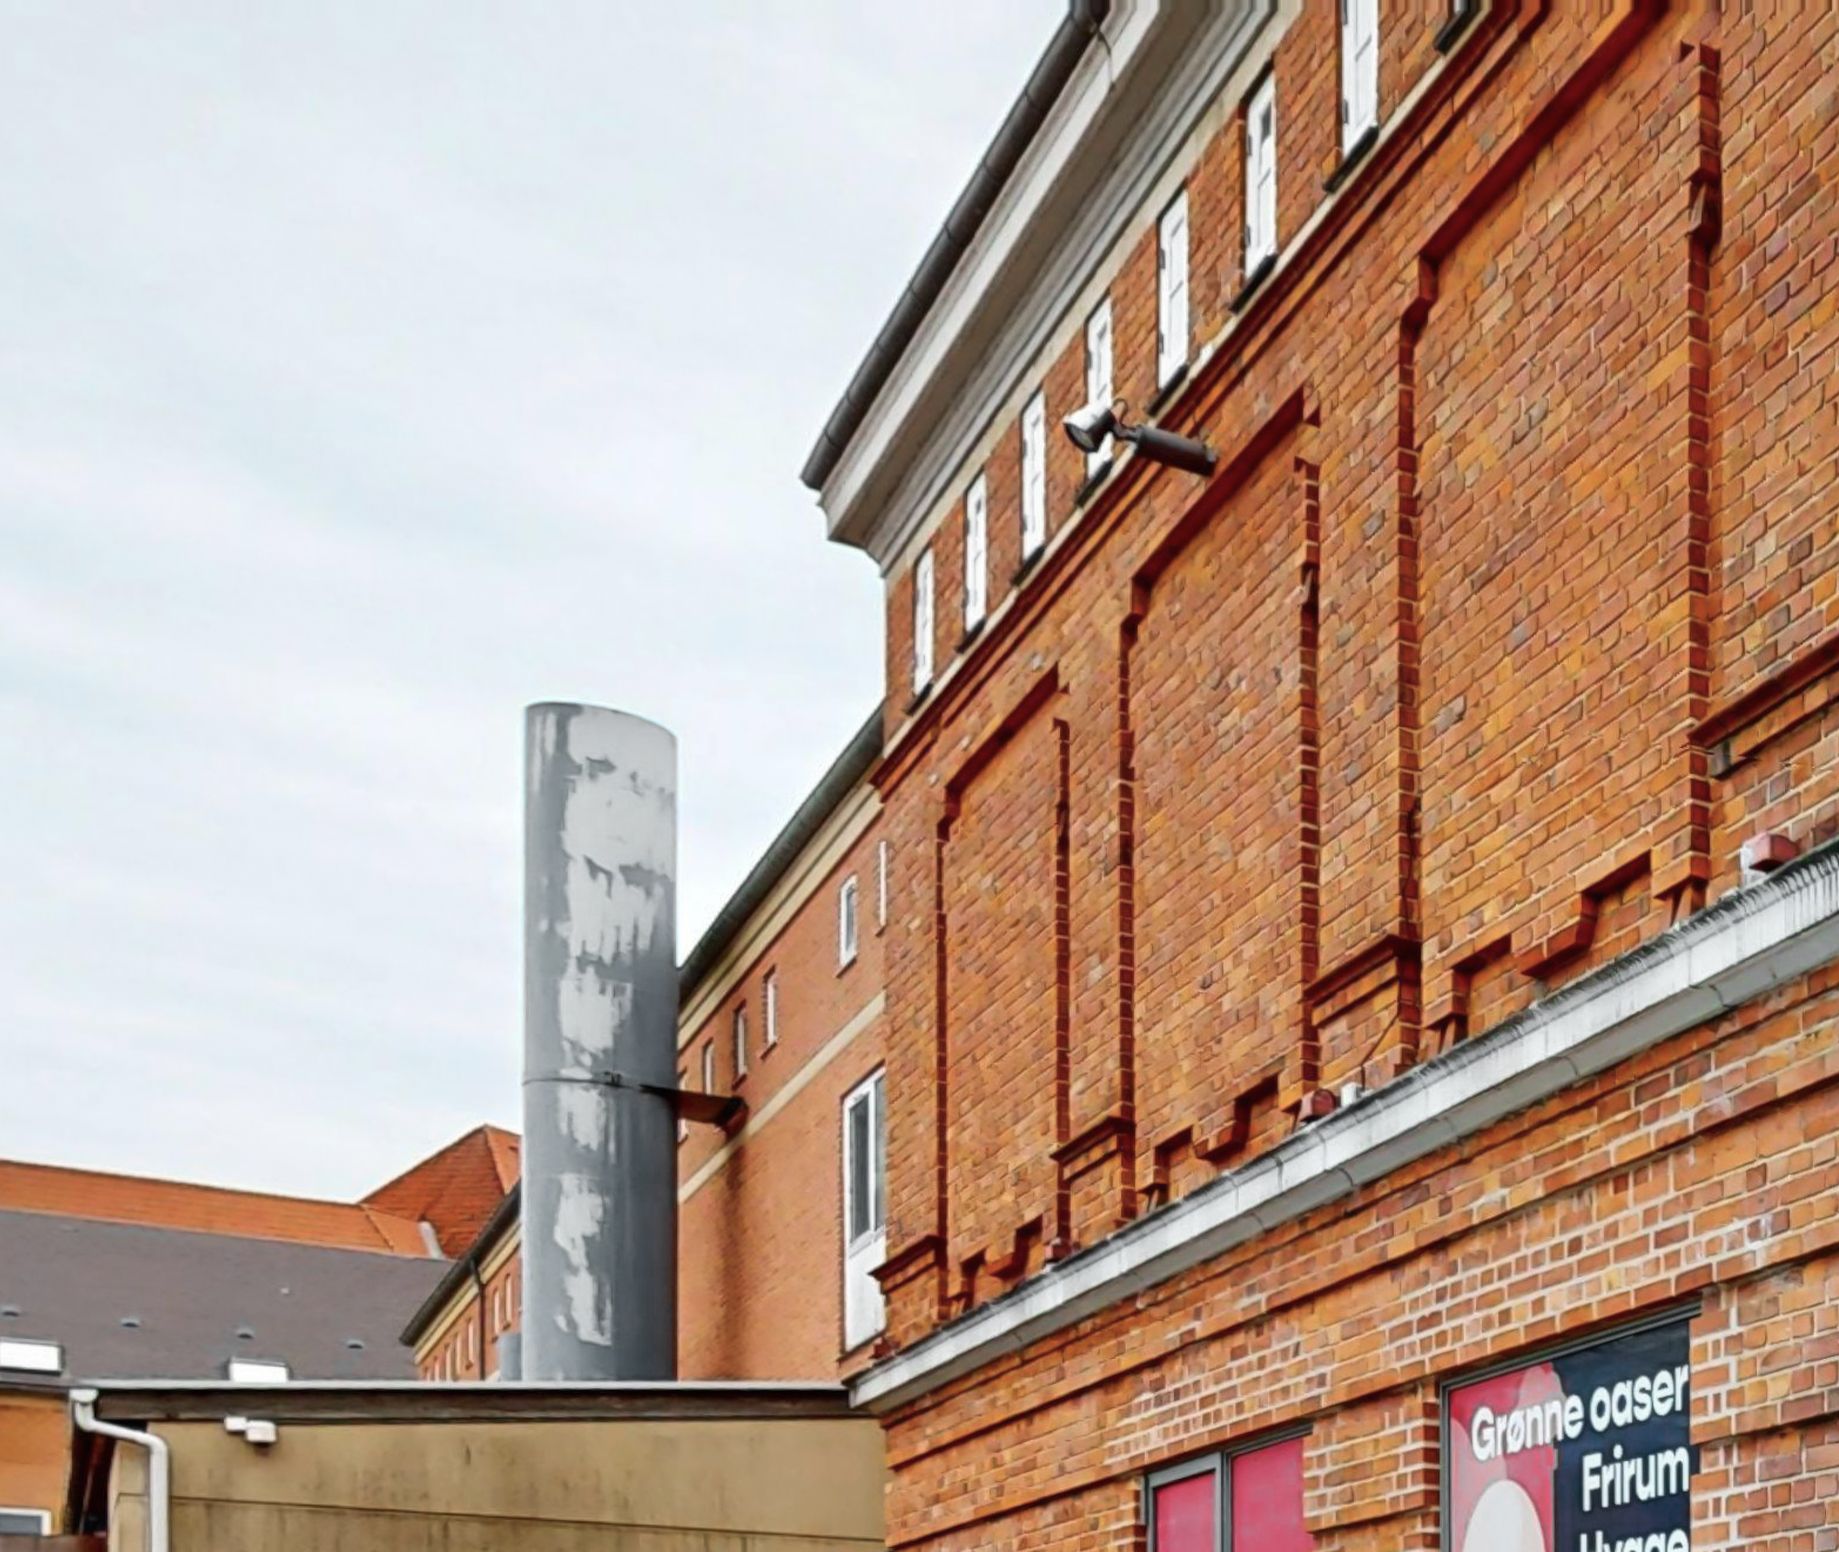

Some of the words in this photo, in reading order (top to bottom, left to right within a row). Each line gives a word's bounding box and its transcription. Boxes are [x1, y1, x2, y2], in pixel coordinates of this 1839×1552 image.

[1471, 1394, 1584, 1461] Grønne
[1590, 1365, 1689, 1432] oaser
[1582, 1444, 1690, 1512] Frirum
